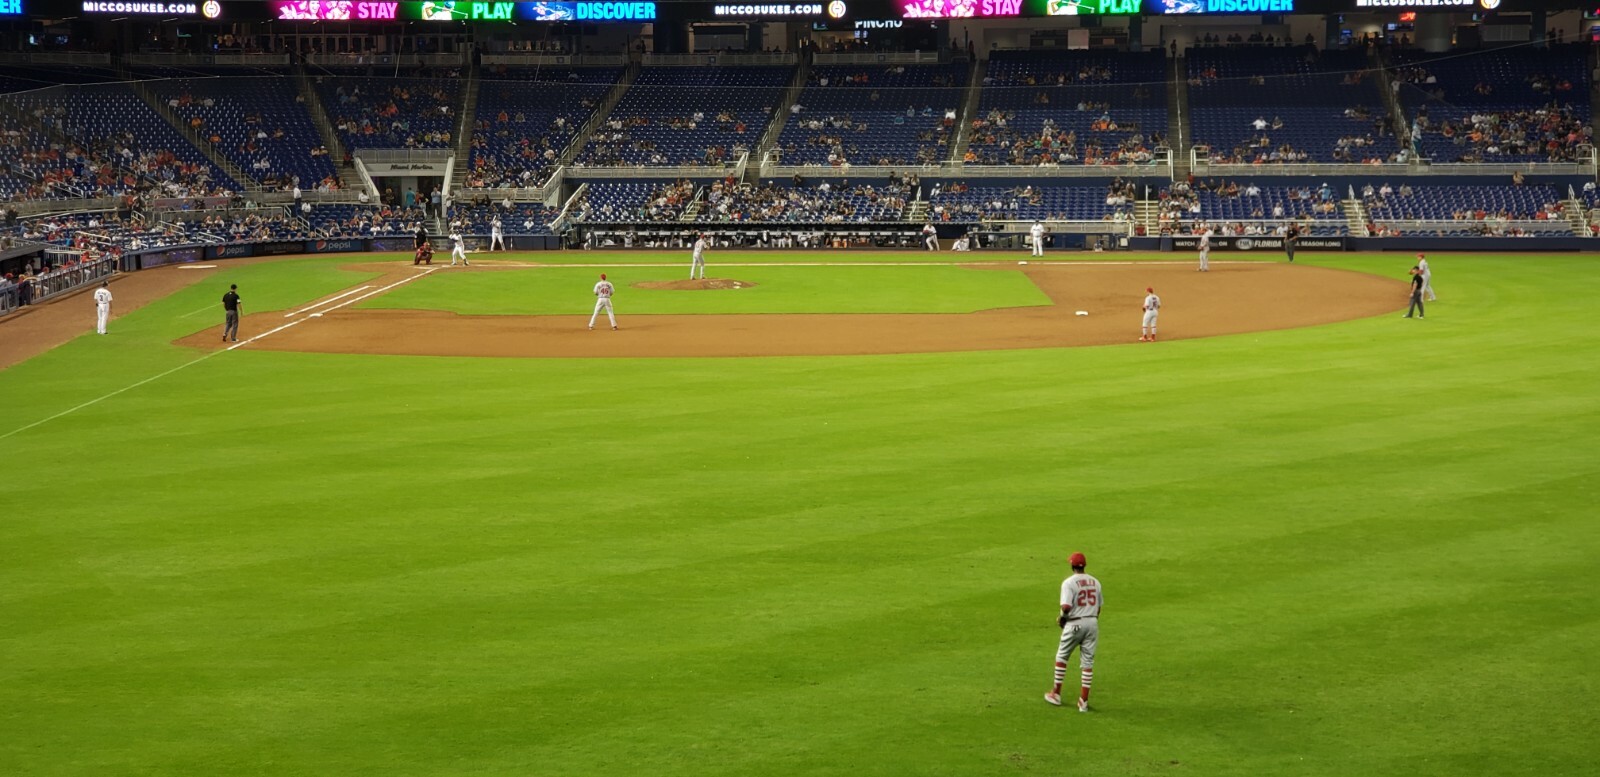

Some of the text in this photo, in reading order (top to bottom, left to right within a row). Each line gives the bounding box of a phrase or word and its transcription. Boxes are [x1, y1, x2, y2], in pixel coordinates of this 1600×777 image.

[83, 2, 197, 13] MICCOSUKEE.COM
[357, 2, 398, 19] STAY
[472, 2, 514, 19] PLAY
[576, 2, 656, 19] DISCOVER
[714, 4, 822, 15] MICCOSUKEE.COM
[982, 0, 1023, 15] STAY
[1098, 0, 1142, 14] PLAY
[1207, 0, 1294, 12] DISCOVER
[226, 246, 245, 255] pepsi
[328, 241, 351, 250] pepsi
[1077, 589, 1096, 607] 25
